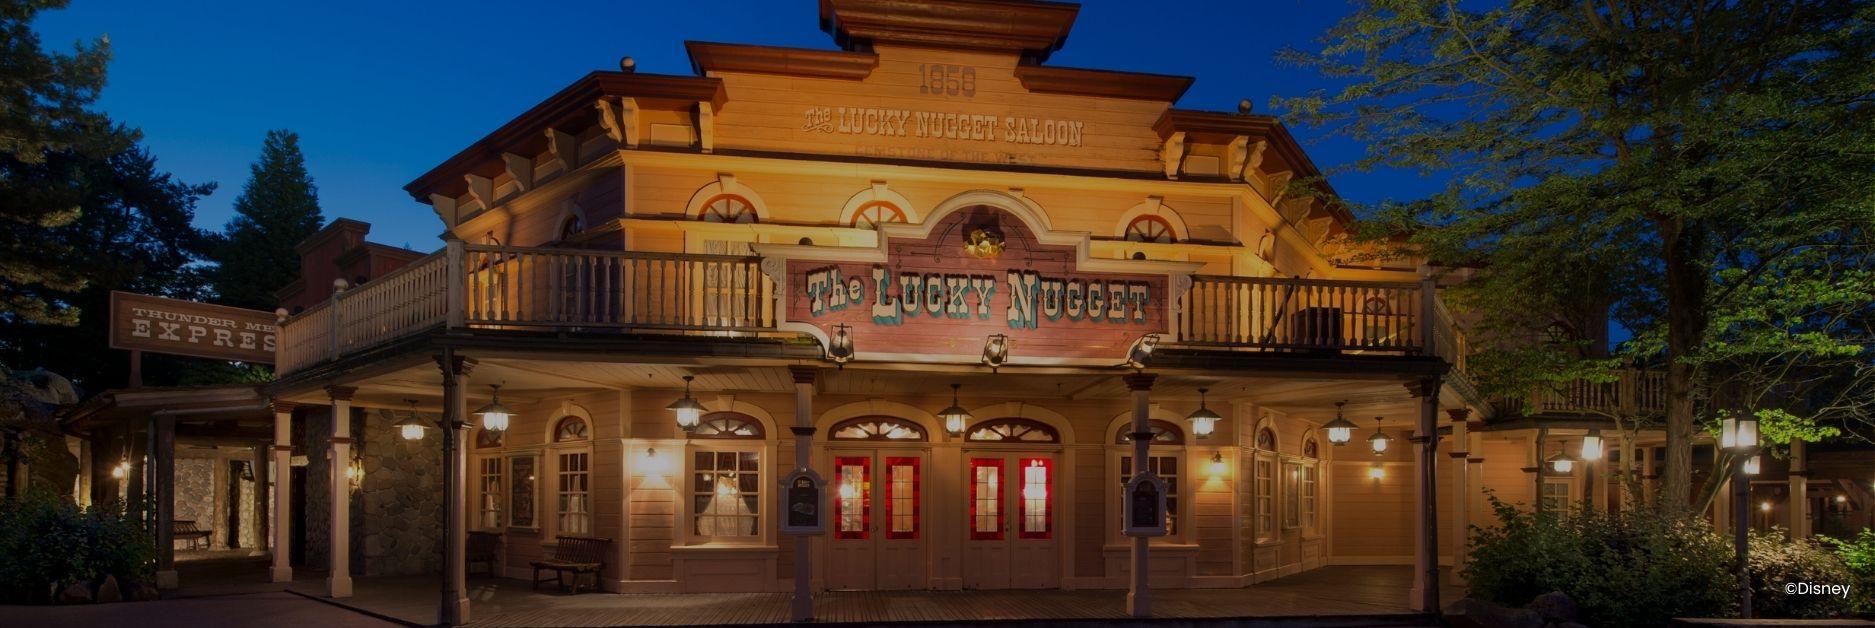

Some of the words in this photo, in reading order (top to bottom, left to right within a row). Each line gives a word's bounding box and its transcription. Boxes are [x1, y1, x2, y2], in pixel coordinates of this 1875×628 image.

[918, 63, 976, 97] 1858
[802, 106, 834, 133] The
[837, 107, 911, 137] LUCKY
[915, 111, 998, 142] NUGGET
[1004, 117, 1084, 147] SALOON
[805, 265, 864, 316] The
[872, 264, 996, 326] LUCKY
[1007, 269, 1151, 330] NUGGET
[132, 307, 238, 329] THUNDER
